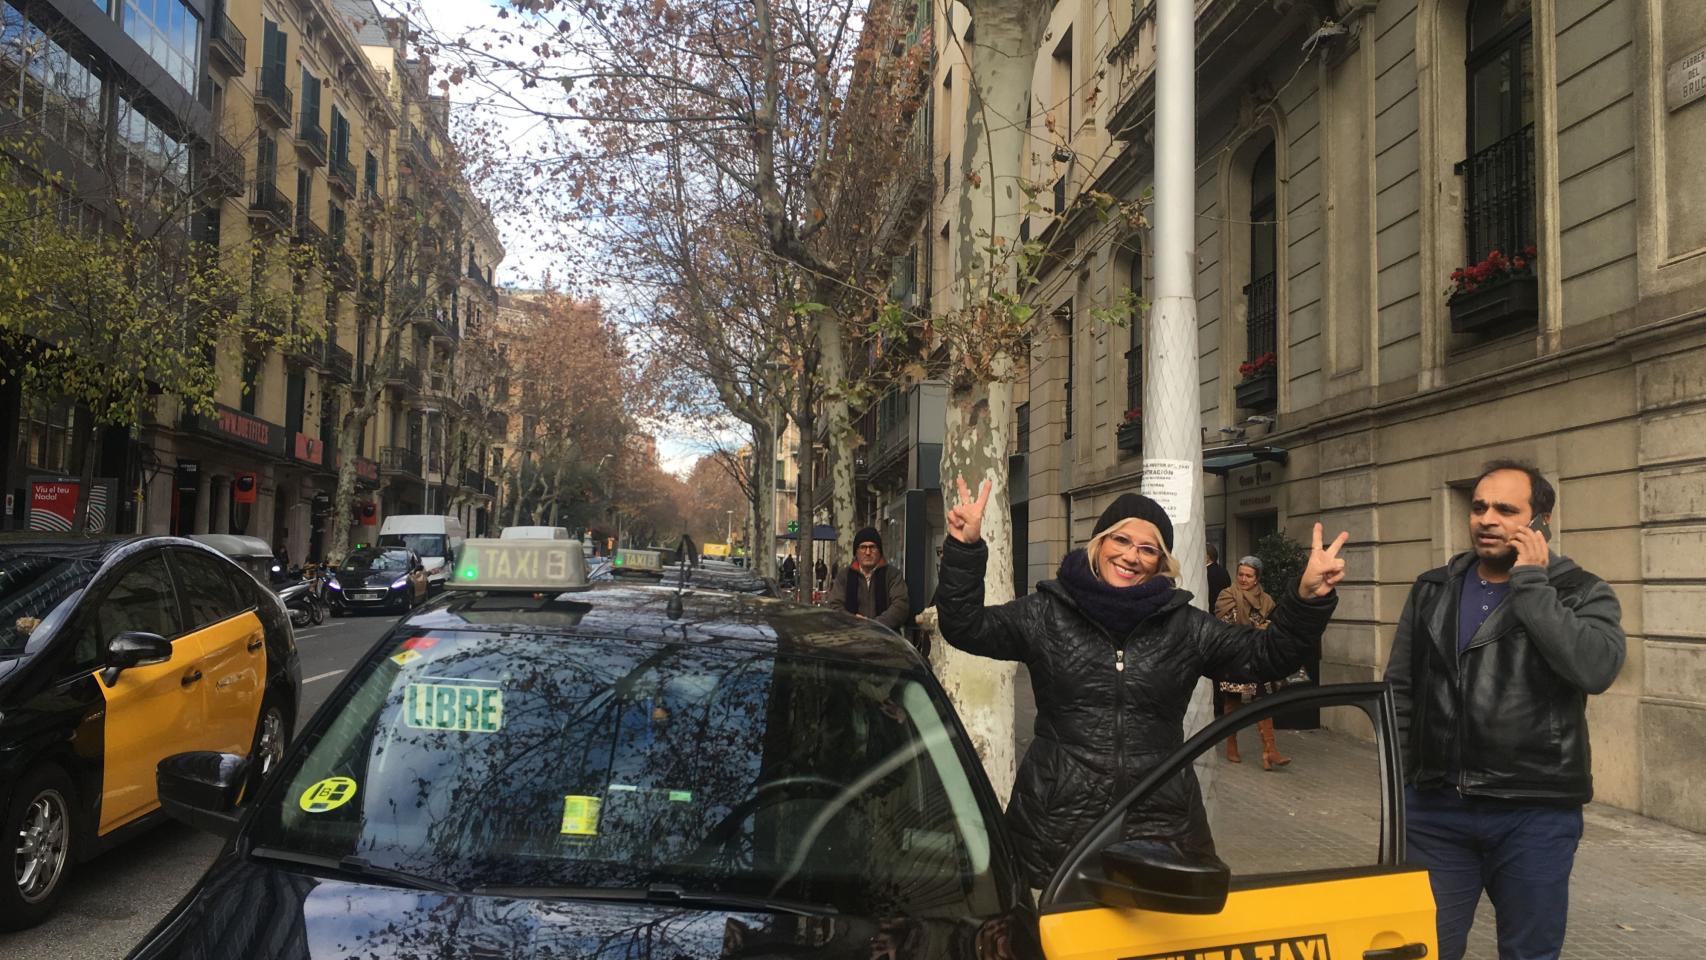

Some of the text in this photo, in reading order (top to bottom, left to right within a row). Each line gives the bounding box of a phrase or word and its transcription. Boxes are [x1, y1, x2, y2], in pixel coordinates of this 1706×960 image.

[1682, 51, 1705, 70] CARRER
[1688, 67, 1700, 80] DEL
[57, 486, 70, 494] teu
[34, 493, 57, 501] Nadal
[486, 549, 539, 578] TAXI
[626, 553, 647, 566] TAXI
[408, 685, 498, 730] LIBRE
